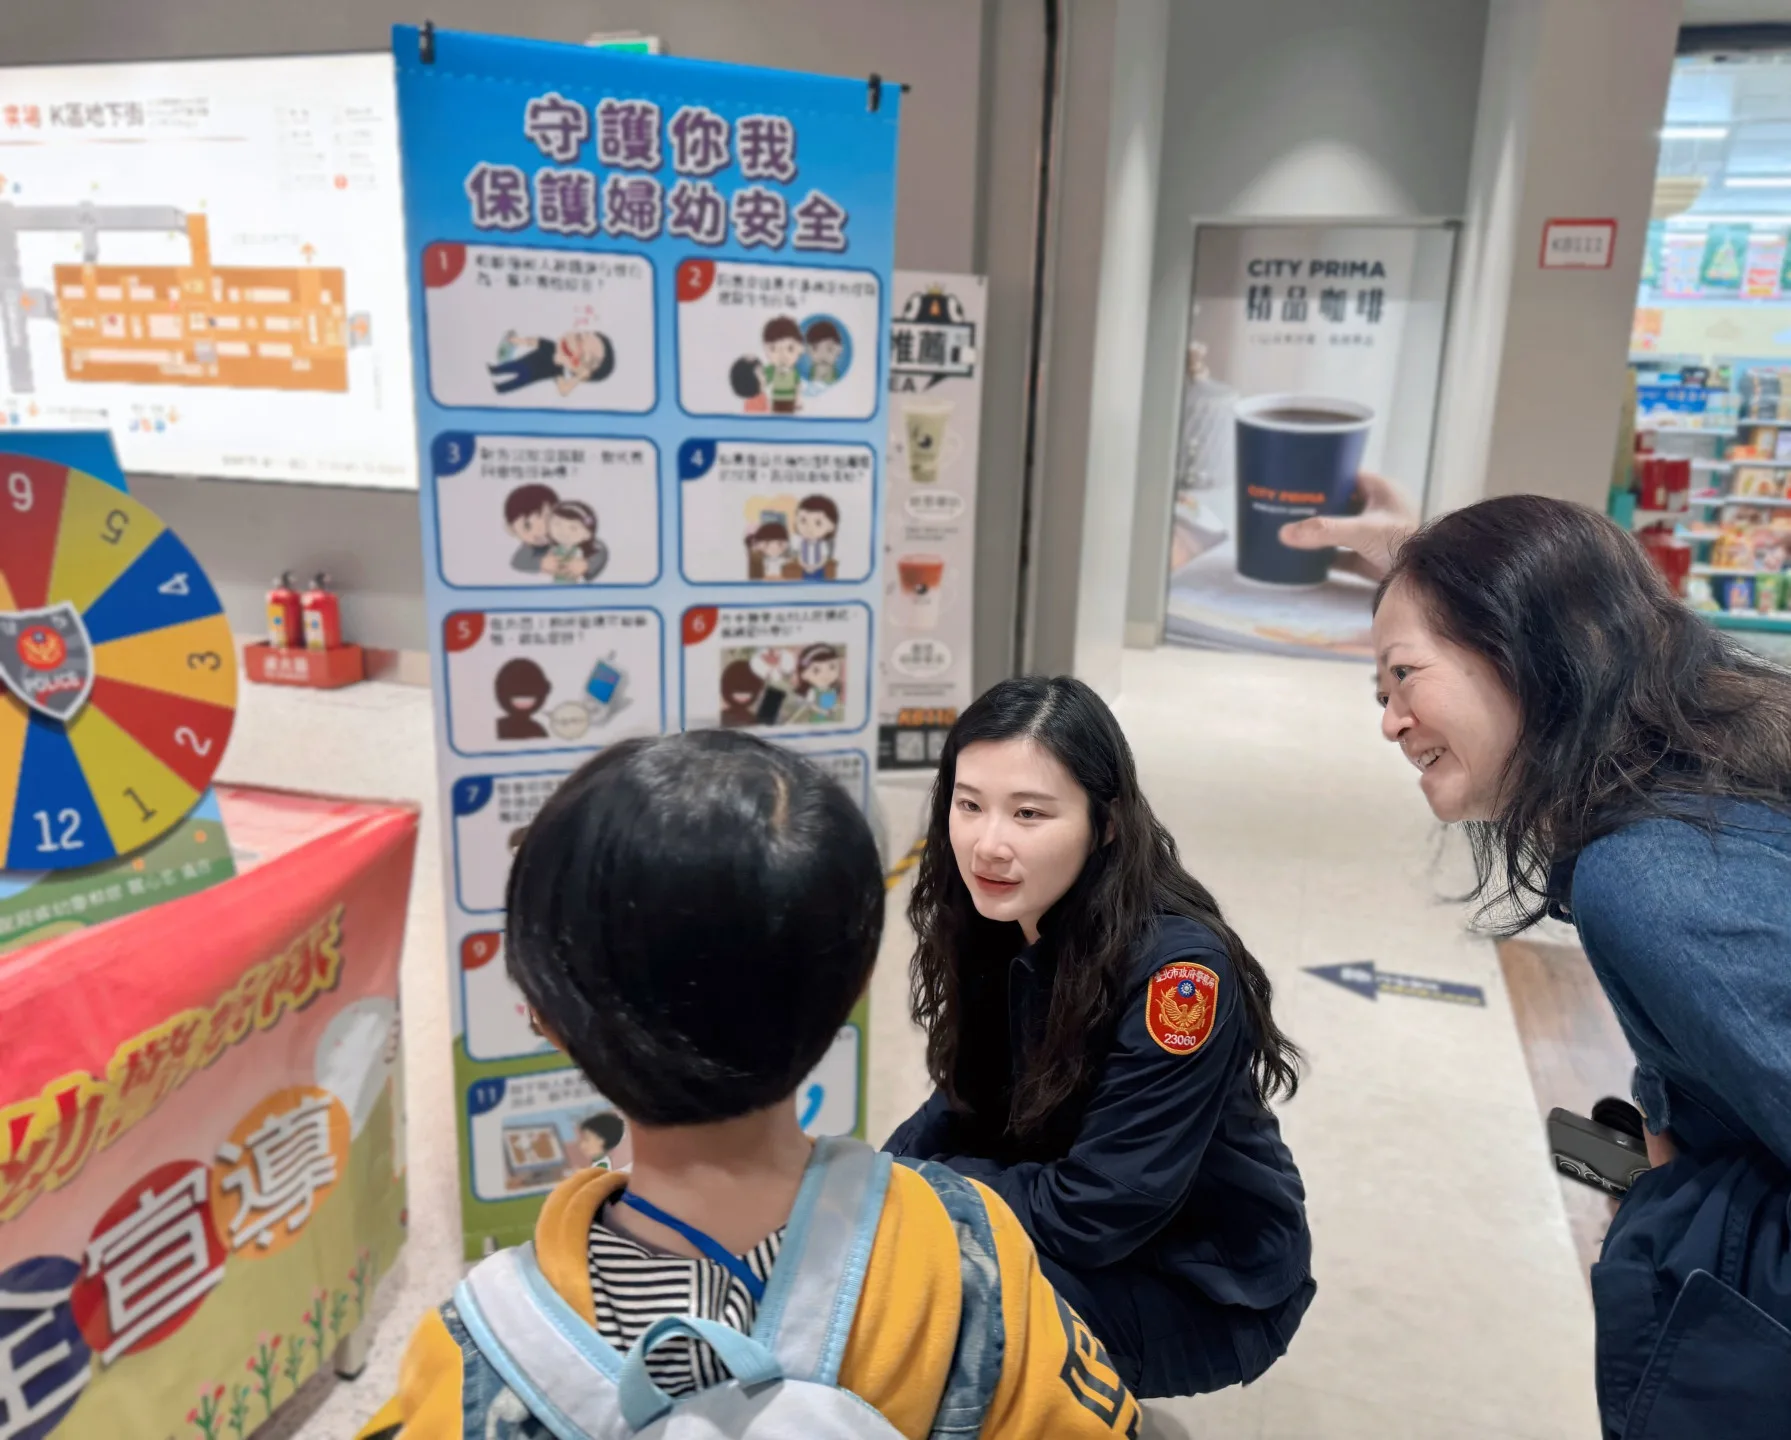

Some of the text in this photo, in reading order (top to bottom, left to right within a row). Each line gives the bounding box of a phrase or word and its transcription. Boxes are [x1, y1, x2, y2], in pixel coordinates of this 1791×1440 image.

[525, 92, 798, 184] 守護你我
[465, 162, 849, 252] 保護婦幼安全
[688, 265, 702, 288] 2
[1247, 258, 1386, 279] CITY PRIMA
[1246, 284, 1385, 324] 精品咖啡
[446, 442, 460, 464] 3
[690, 448, 704, 468] 4
[101, 508, 130, 545] 5
[158, 572, 190, 596] 4
[457, 620, 471, 640] 5
[692, 613, 706, 634] 6
[187, 650, 221, 671] 3
[174, 725, 213, 757] 2
[123, 787, 158, 822] 1
[466, 785, 480, 804] 7
[33, 808, 85, 852] 12
[473, 940, 487, 959] 9
[1164, 1033, 1196, 1046] 23060
[476, 1086, 497, 1103] 11
